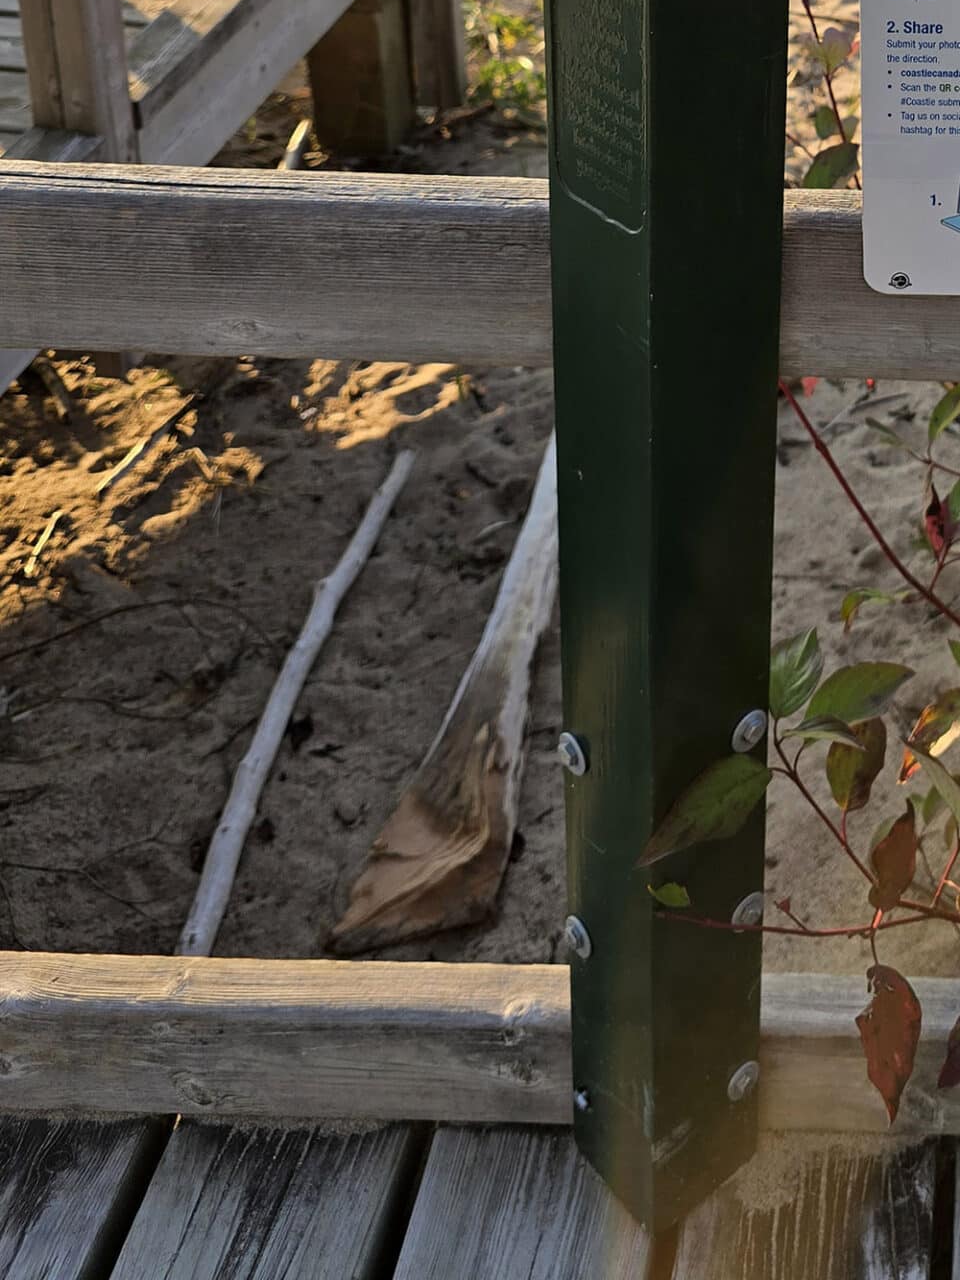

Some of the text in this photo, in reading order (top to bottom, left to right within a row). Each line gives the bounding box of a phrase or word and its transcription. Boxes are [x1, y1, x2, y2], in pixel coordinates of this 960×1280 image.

[886, 19, 942, 33] 2. Share
[886, 39, 915, 47] Submit
[918, 41, 935, 50] your
[887, 53, 940, 62] the direction.
[900, 82, 921, 91] Scan
[923, 82, 936, 91] the
[939, 83, 951, 91] QR
[900, 96, 935, 105] #Coastie
[900, 111, 915, 121] Tag
[900, 124, 932, 135] hashtag
[935, 125, 945, 134] for
[930, 194, 942, 206] 1.
